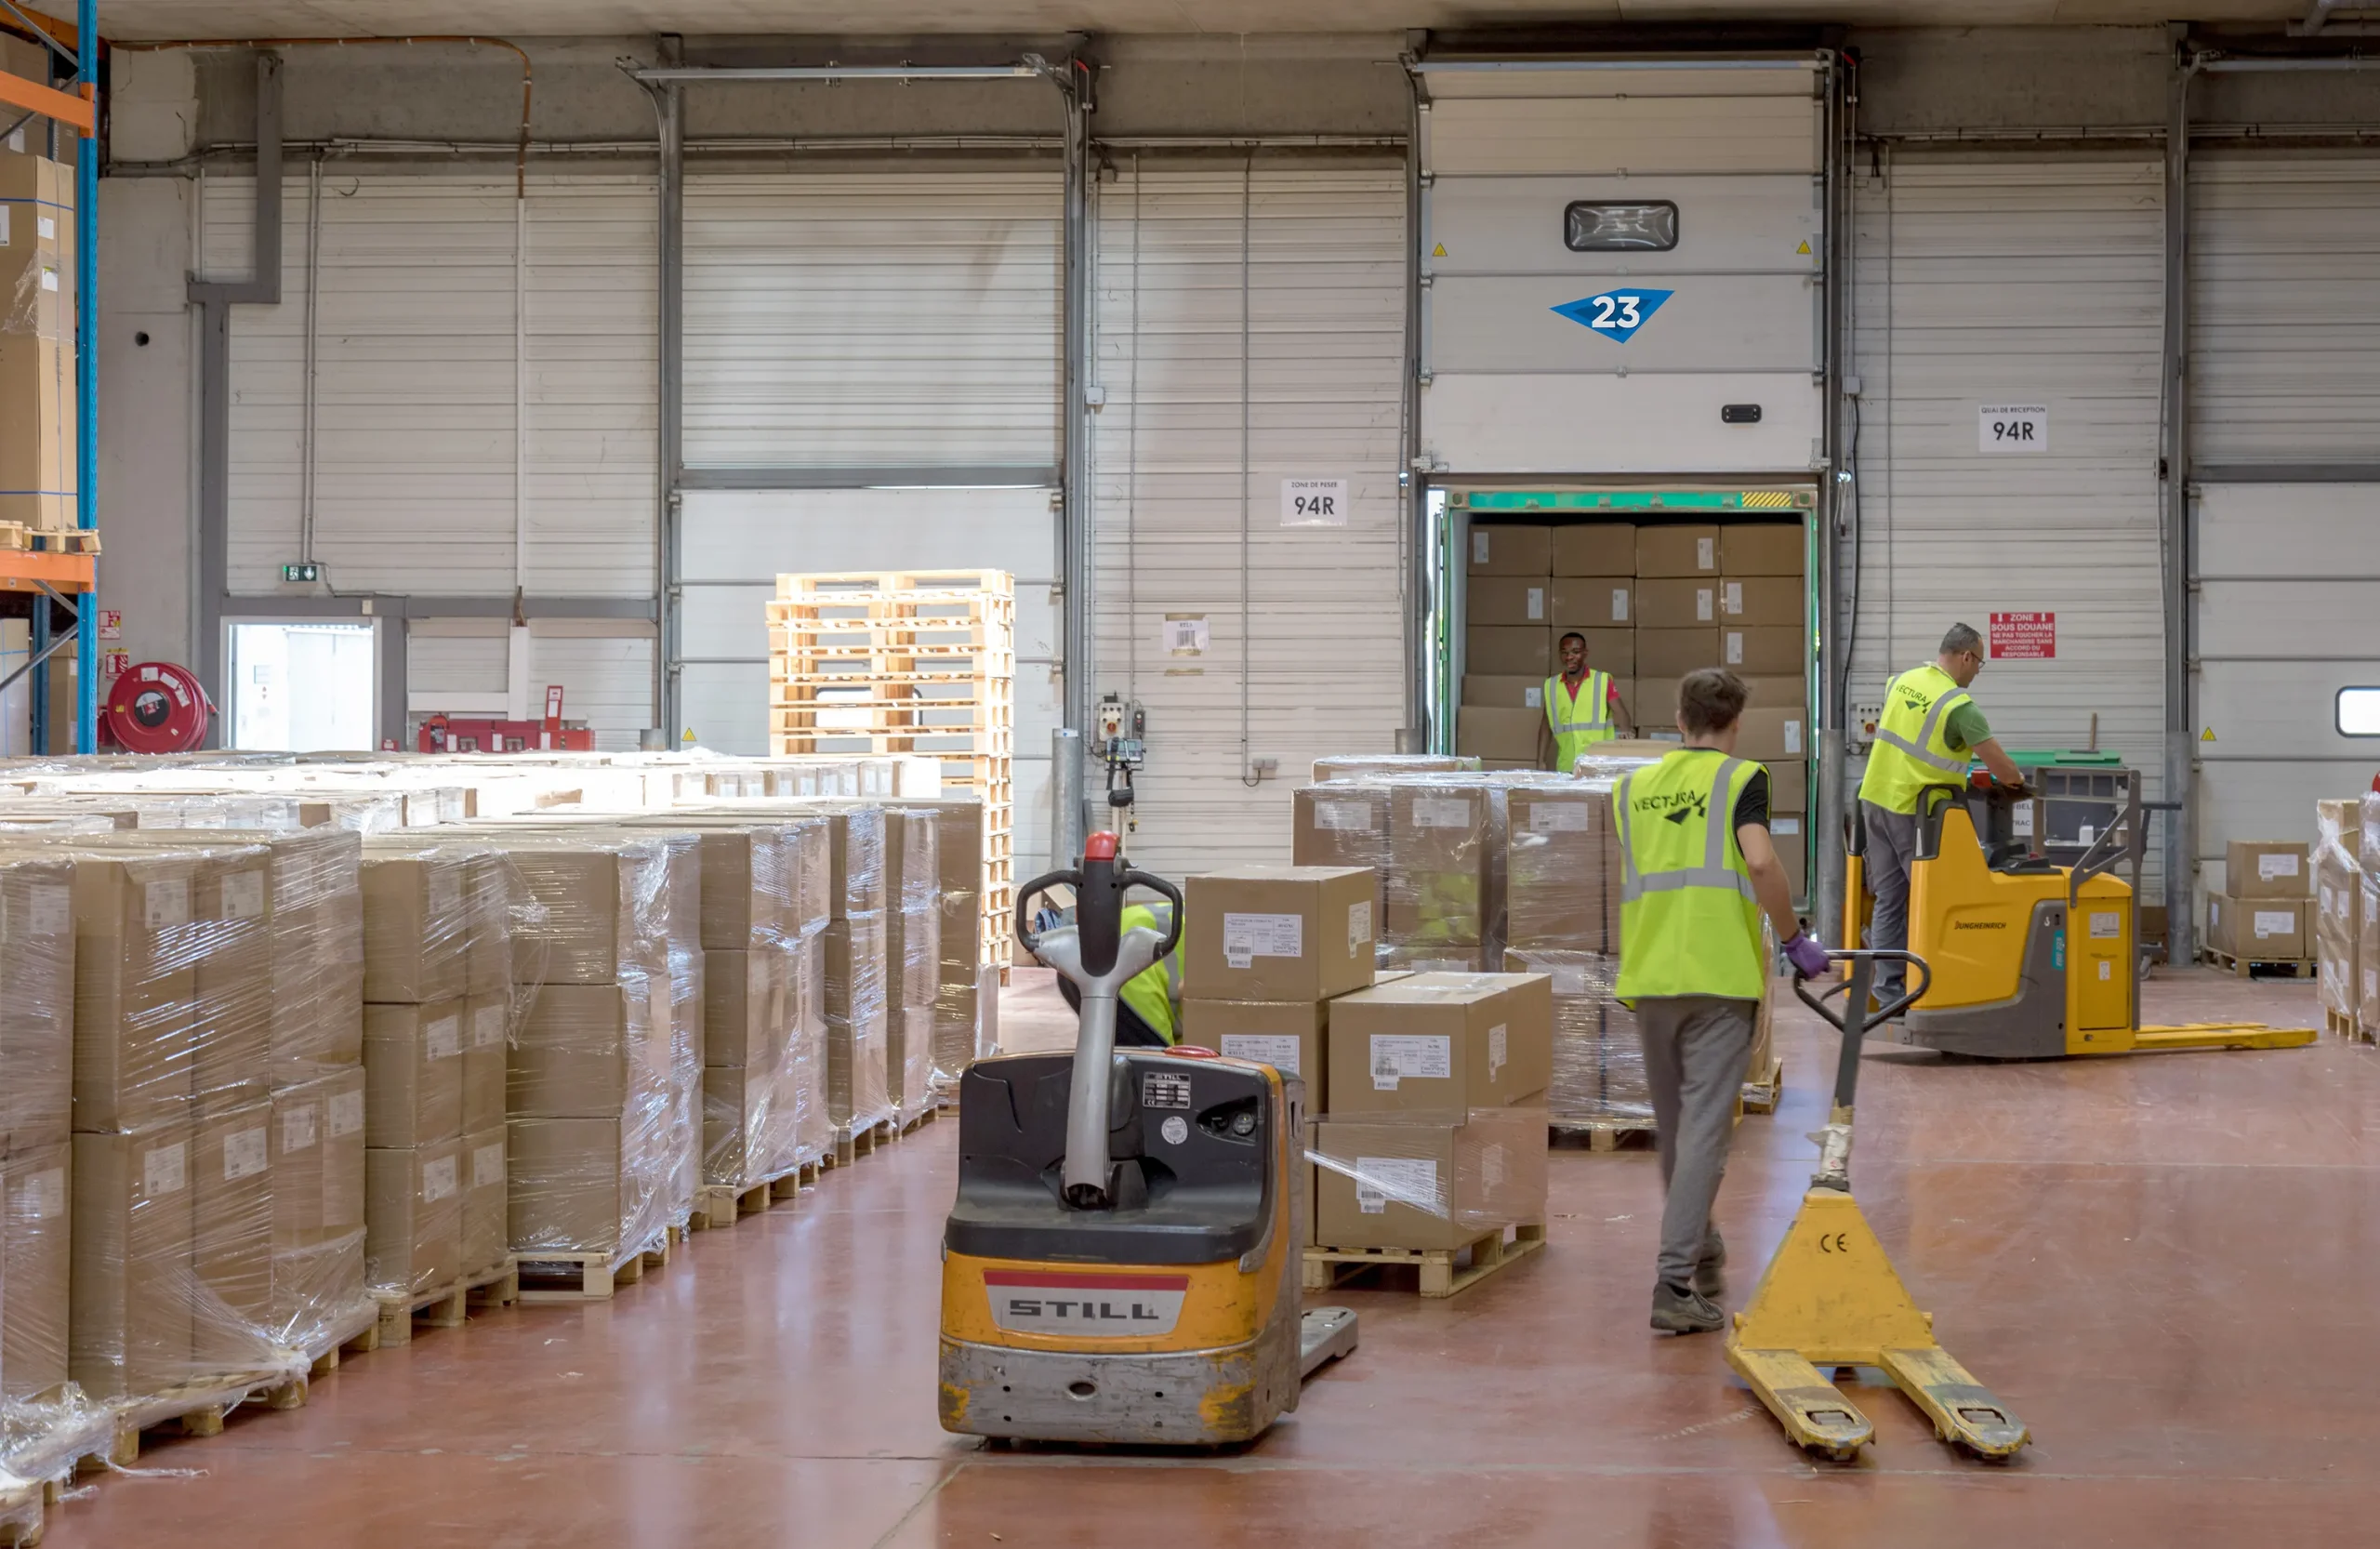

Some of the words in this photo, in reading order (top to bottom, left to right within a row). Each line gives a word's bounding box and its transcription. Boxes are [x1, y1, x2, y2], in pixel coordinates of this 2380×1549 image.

[1592, 296, 1640, 328] 23
[1993, 421, 2034, 441] 94R
[1294, 496, 1335, 515] 94R
[1991, 623, 2015, 631] SOUS
[2016, 623, 2054, 631] DOUANE
[1954, 920, 2006, 930] JUNGHEINRICH
[1820, 1233, 1847, 1253] CE
[1010, 1299, 1159, 1319] STILL
